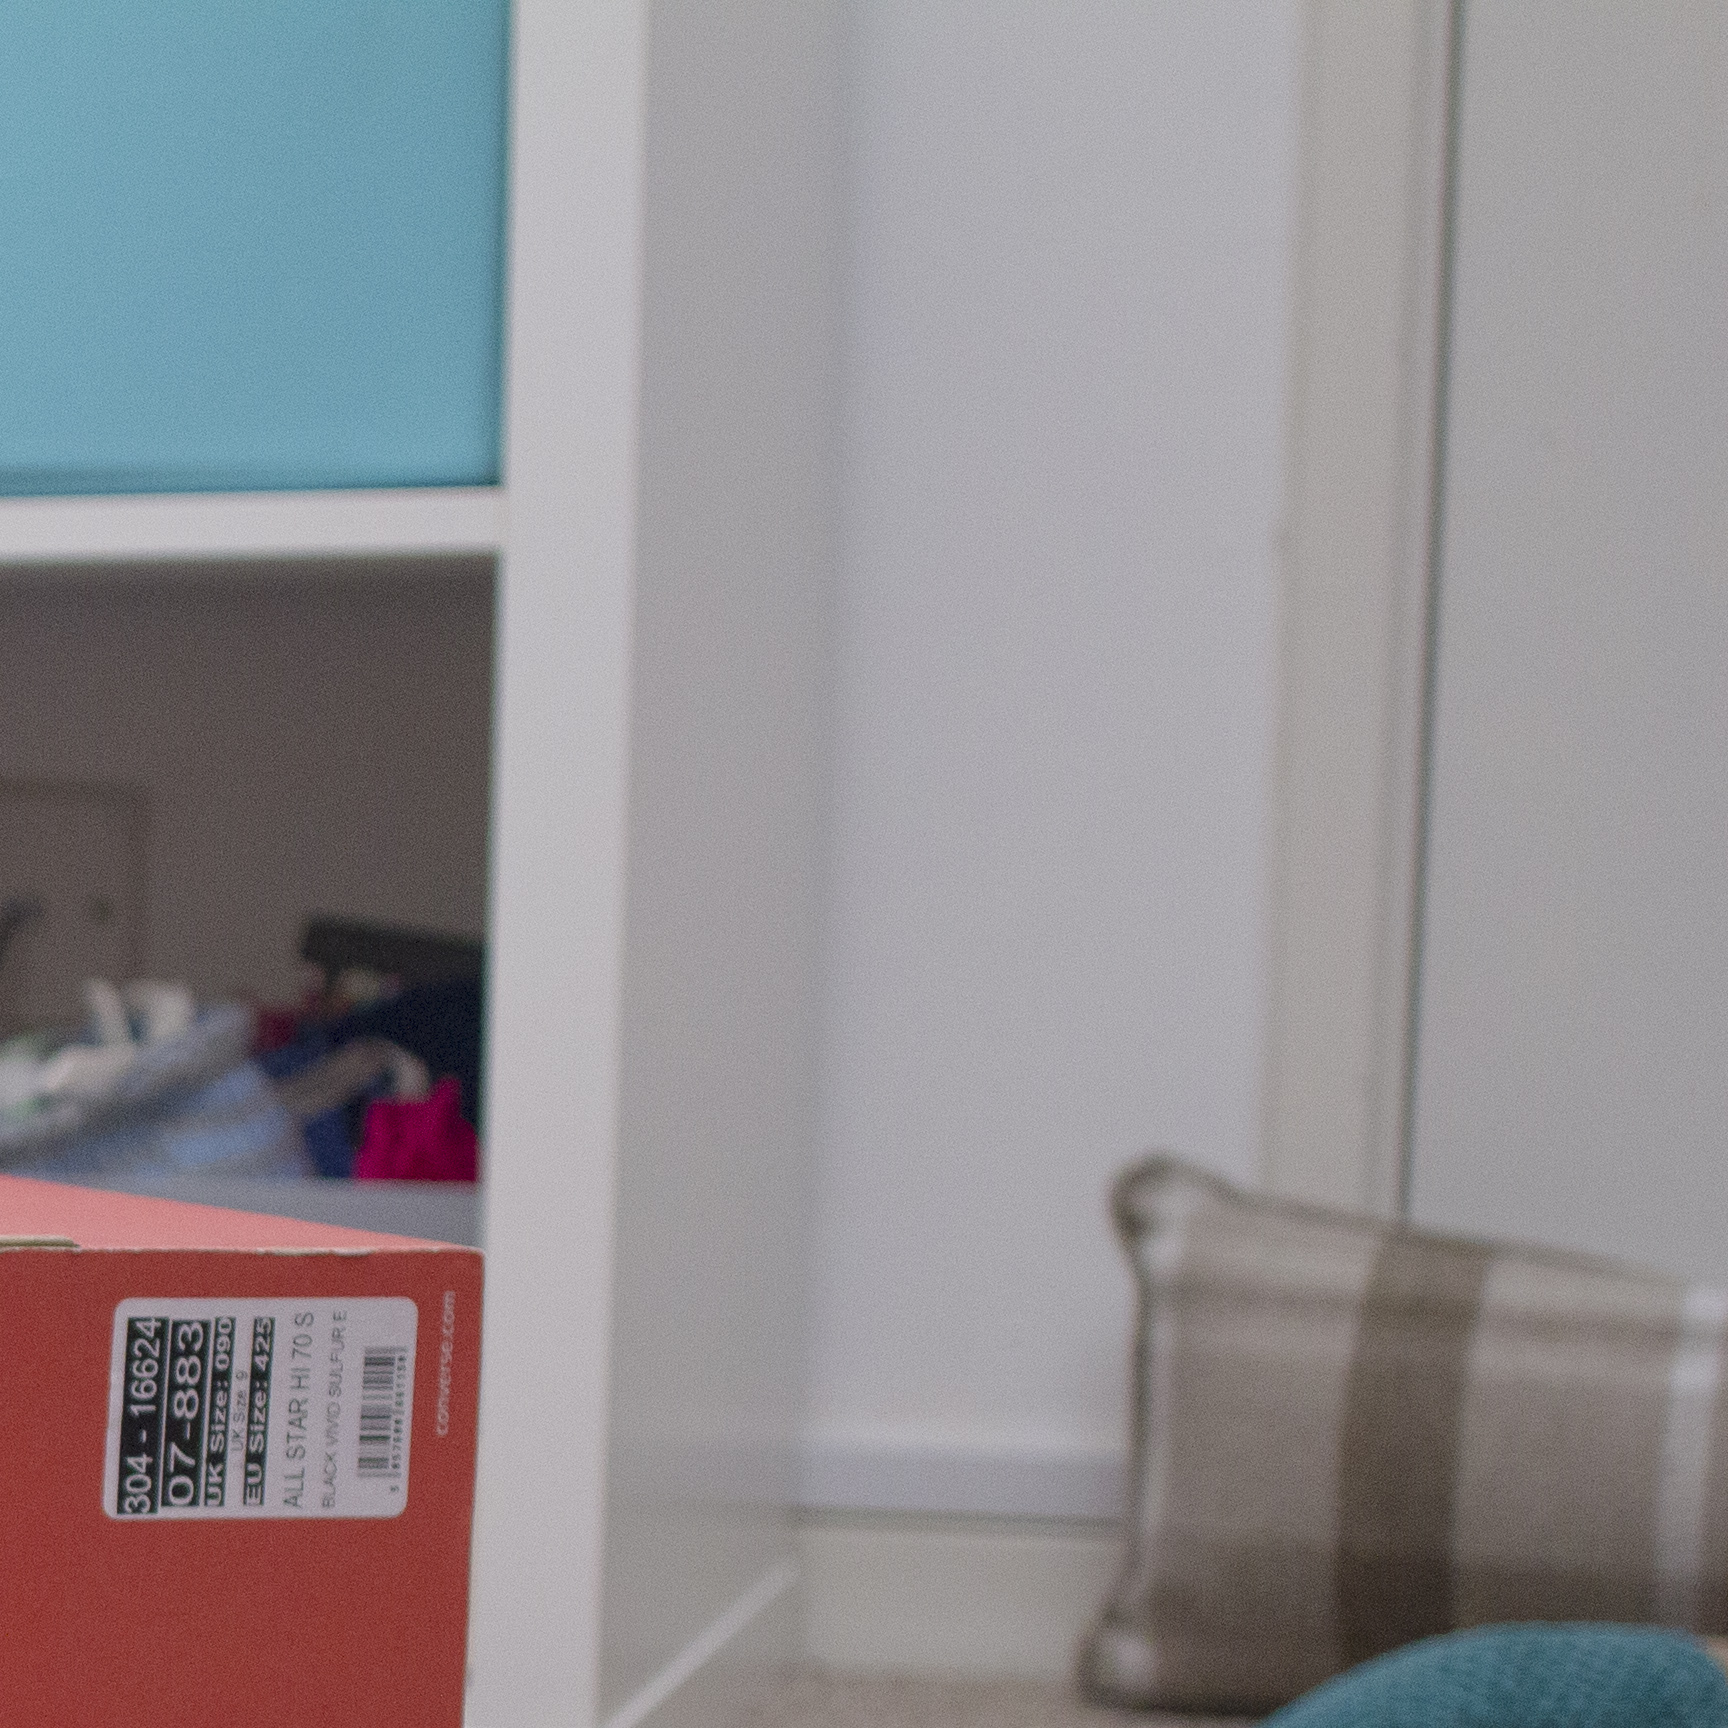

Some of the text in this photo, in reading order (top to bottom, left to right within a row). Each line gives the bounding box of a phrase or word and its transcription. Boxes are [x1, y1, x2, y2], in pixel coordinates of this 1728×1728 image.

[129, 1317, 162, 1418] 16624
[168, 1321, 204, 1506] 07-883
[207, 1316, 233, 1506] UK Size: 090
[246, 1317, 272, 1507] EU Size: 425
[283, 1312, 315, 1509] ALL STAR HI 70 S
[328, 1325, 346, 1398] SULFUR
[436, 1291, 456, 1436] converse.com
[123, 1453, 153, 1514] 304
[231, 1429, 244, 1451] UK
[322, 1451, 338, 1509] BLACK
